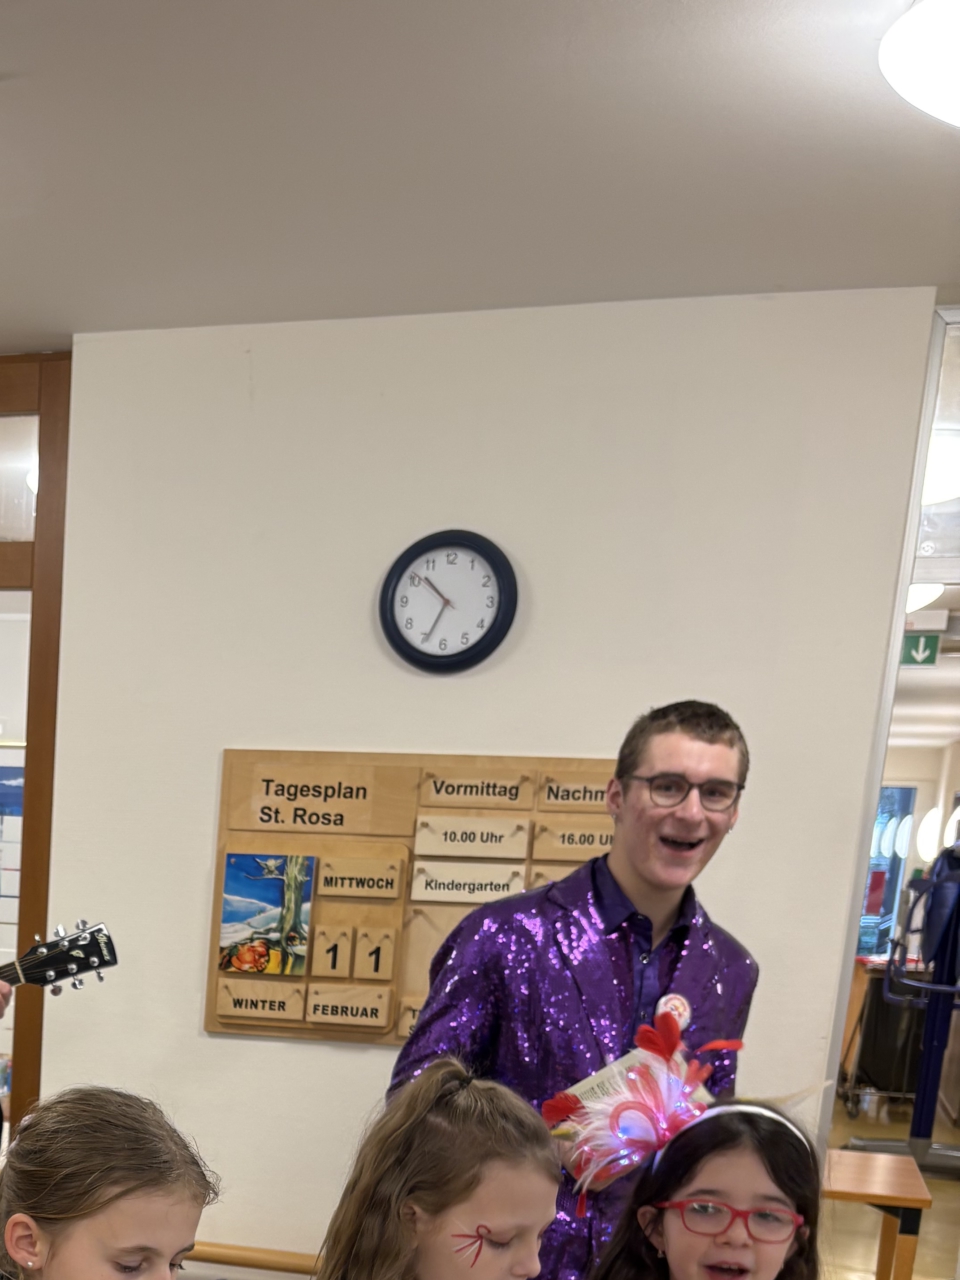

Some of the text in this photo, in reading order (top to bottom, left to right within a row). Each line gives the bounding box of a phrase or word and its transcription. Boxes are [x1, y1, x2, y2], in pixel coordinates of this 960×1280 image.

[425, 558, 436, 571] 11
[445, 552, 458, 565] 12
[469, 558, 475, 571] 1
[409, 574, 421, 587] 10
[481, 575, 491, 588] 2
[400, 595, 408, 608] 9
[486, 596, 494, 608] 3
[405, 618, 413, 630] 8
[477, 618, 485, 630] 4
[439, 638, 447, 651] 6
[461, 632, 469, 645] 5
[262, 779, 367, 802] Tagesplan
[433, 780, 519, 801] Vormittag
[547, 785, 607, 802] Nachm
[259, 806, 344, 826] St. Rosa
[442, 831, 504, 844] 10.00 Uhr
[560, 833, 595, 845] 16.00
[323, 876, 394, 889] MITTWOCH
[425, 879, 510, 894] Kindergarten
[233, 998, 286, 1012] WINTER
[313, 1004, 379, 1019] FEBRUAR
